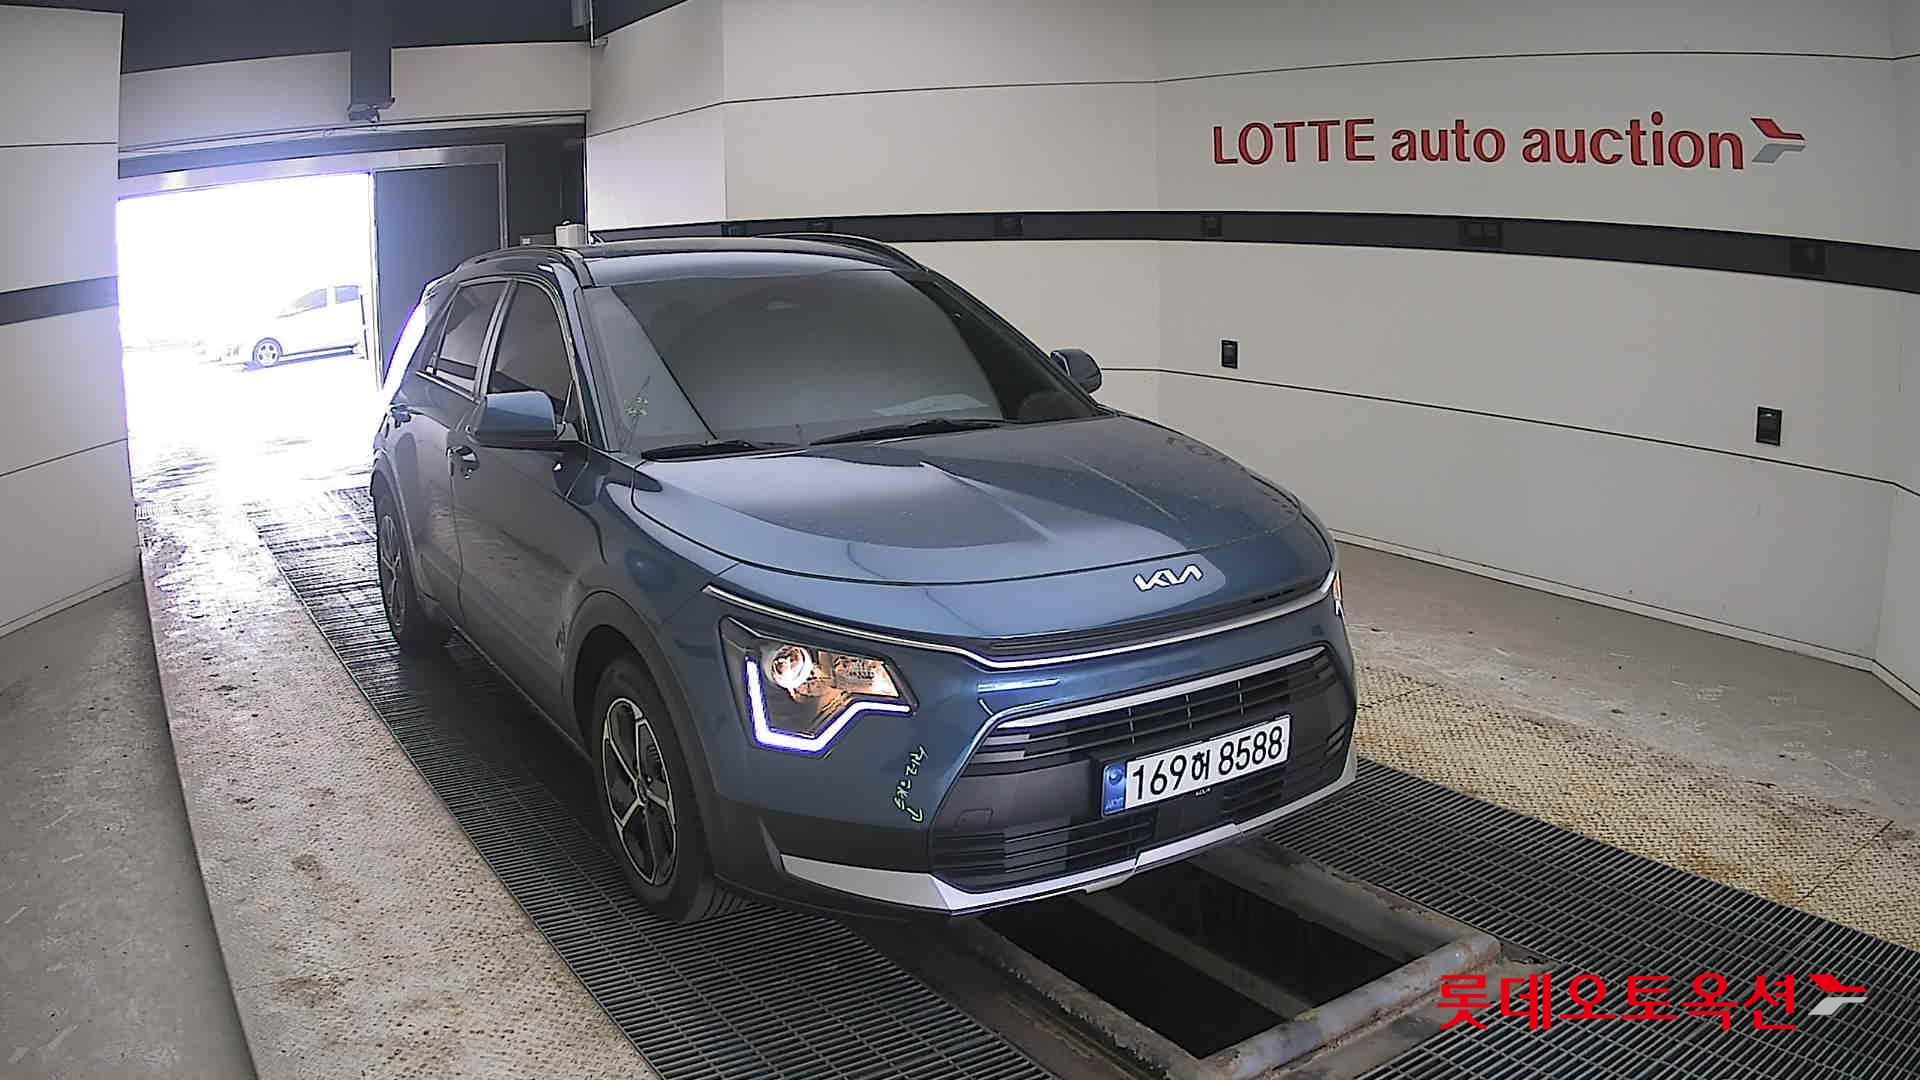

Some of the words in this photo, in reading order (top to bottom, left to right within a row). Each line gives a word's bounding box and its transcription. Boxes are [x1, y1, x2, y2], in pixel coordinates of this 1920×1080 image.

[1212, 118, 1376, 164] LOTTE
[1391, 119, 1506, 162] auto
[1522, 111, 1744, 169] auction
[1218, 726, 1283, 776] 8588
